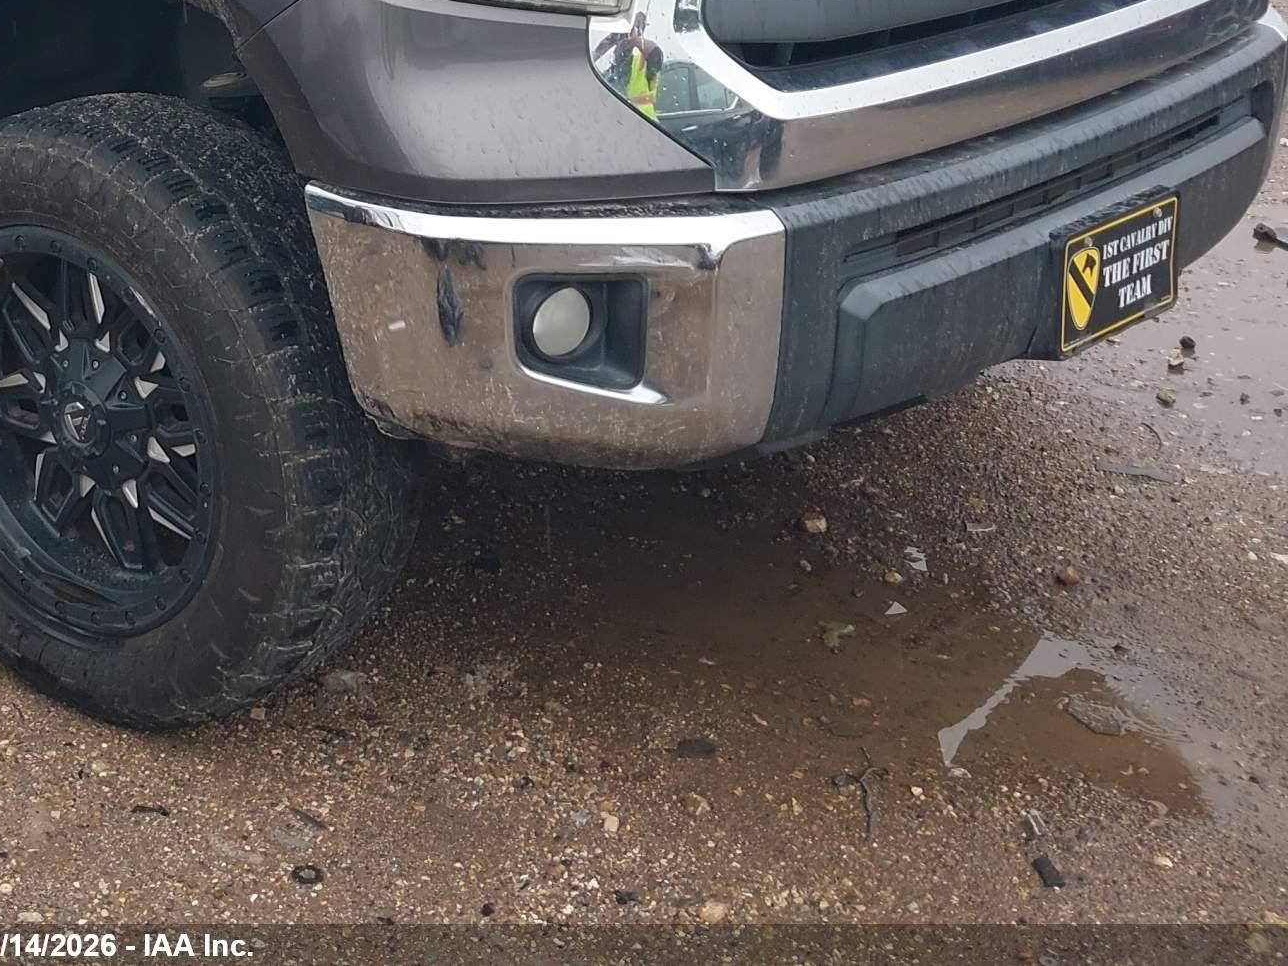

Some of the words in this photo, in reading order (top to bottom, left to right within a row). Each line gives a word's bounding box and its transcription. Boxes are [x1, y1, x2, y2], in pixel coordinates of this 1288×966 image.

[1102, 237, 1120, 261] 1ST
[1119, 223, 1158, 253] CAVALRY
[1157, 216, 1174, 236] DIV
[1103, 257, 1132, 288] THE
[1132, 239, 1170, 275] FIRST
[1118, 274, 1152, 308] TEAM
